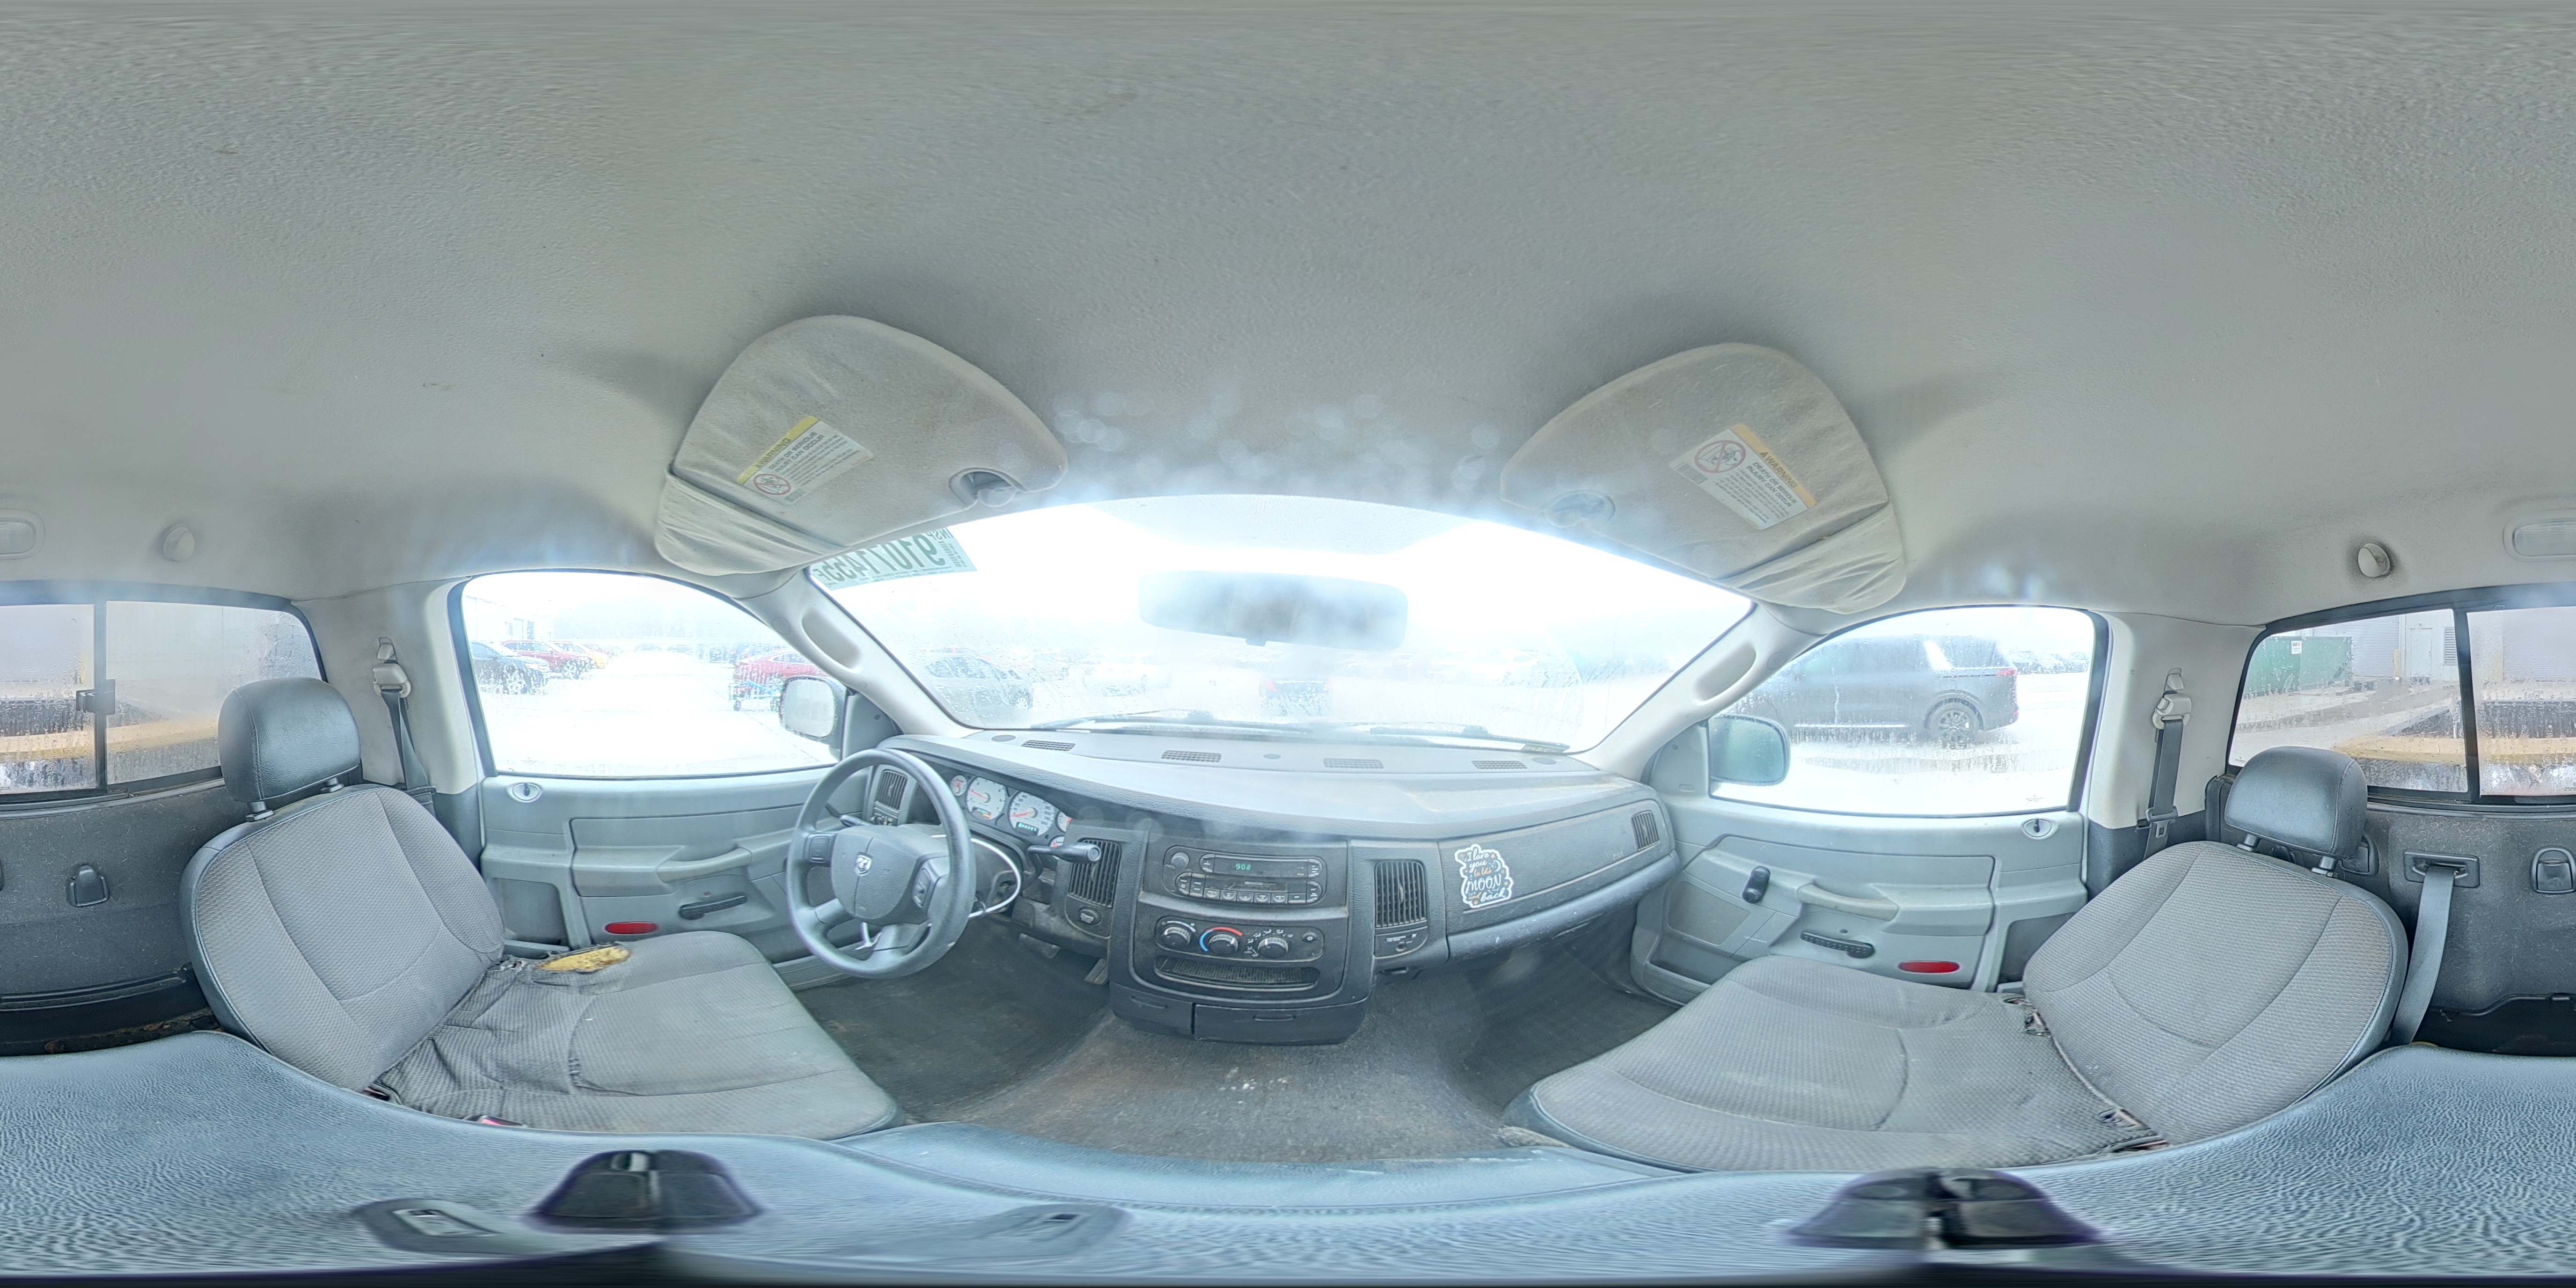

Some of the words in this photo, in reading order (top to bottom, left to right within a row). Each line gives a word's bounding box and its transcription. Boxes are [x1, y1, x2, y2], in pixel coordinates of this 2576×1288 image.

[757, 437, 791, 466] WARNING
[768, 457, 785, 470] DEATH
[792, 432, 818, 451] SERIOUS
[775, 459, 793, 473] INJURY
[791, 450, 804, 460] CAN
[803, 434, 826, 451] OCCUR
[1746, 465, 1766, 483] INJURY
[1764, 483, 1778, 493] CAN
[1752, 461, 1771, 479] DEATH
[1777, 485, 1797, 505] SERIOUS
[1765, 456, 1798, 489] WARNING
[1467, 851, 1472, 861] I
[1473, 848, 1489, 861] love
[1469, 860, 1488, 873] you
[1465, 873, 1501, 894] MOON
[1473, 869, 1481, 877] to
[1481, 867, 1493, 876] the
[1468, 892, 1481, 900] and
[1480, 887, 1507, 902] back
